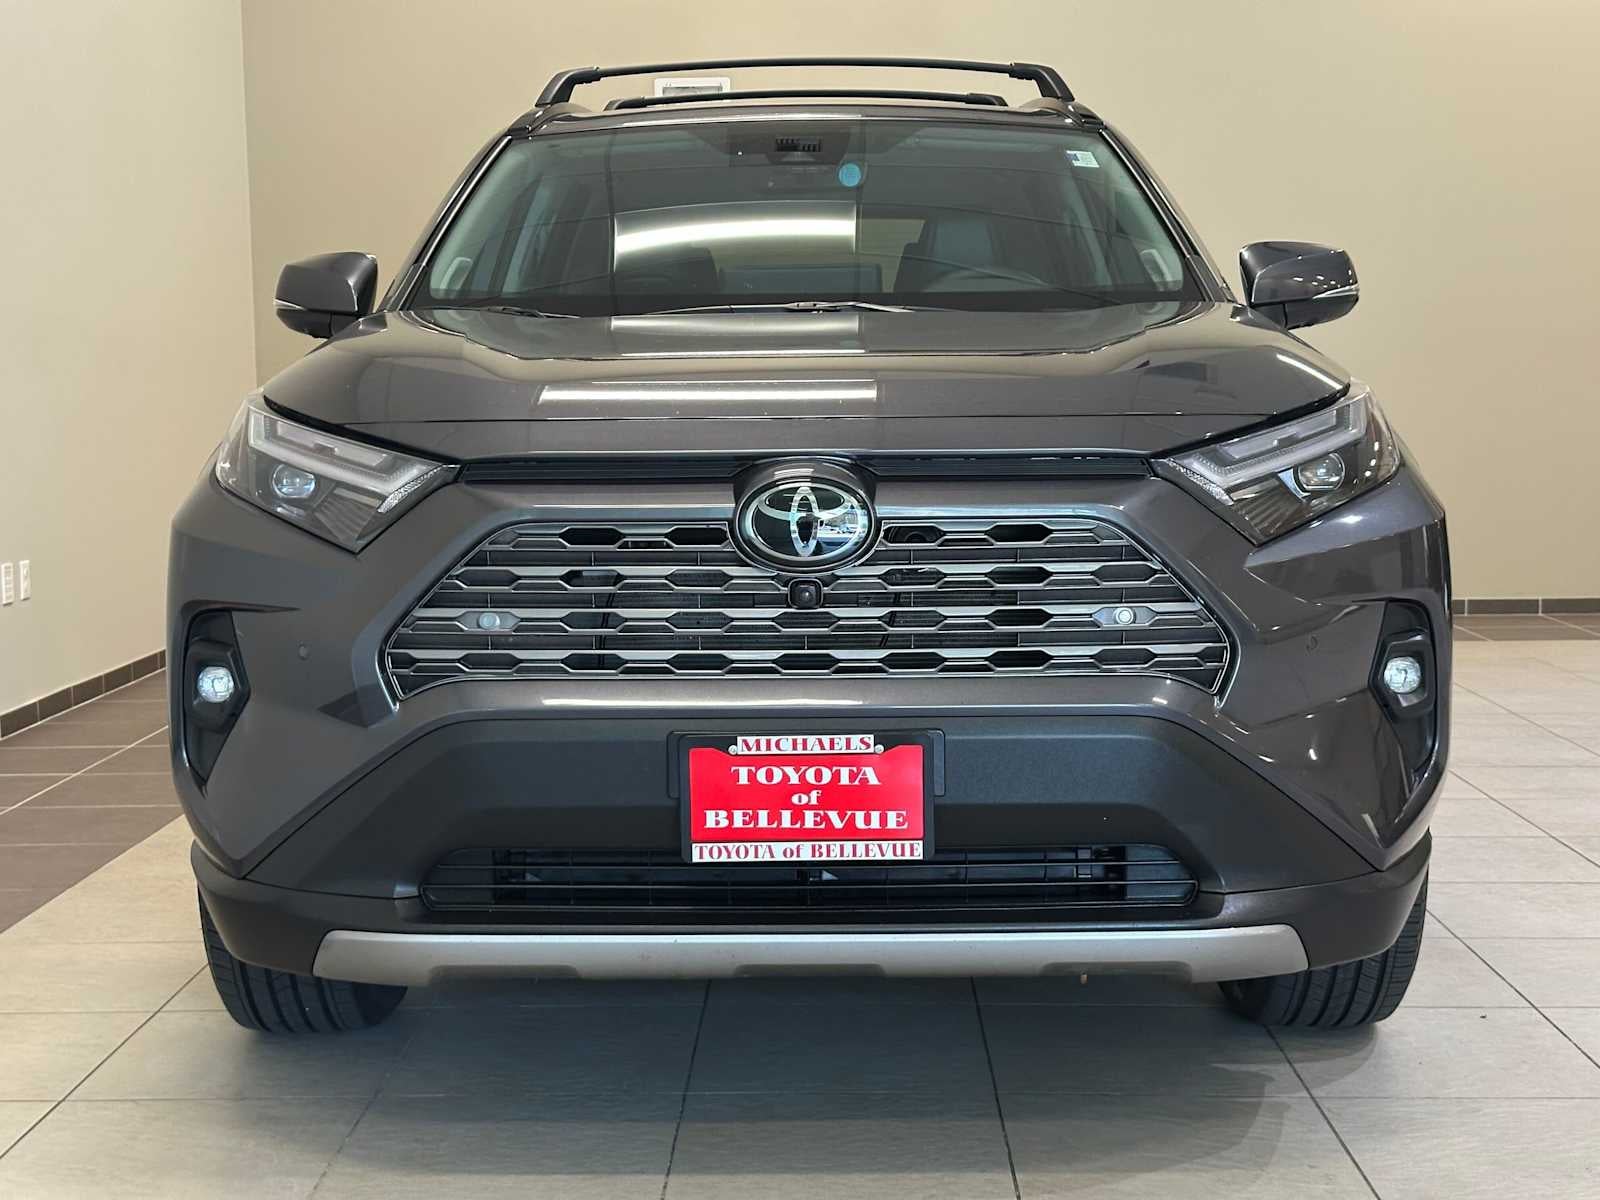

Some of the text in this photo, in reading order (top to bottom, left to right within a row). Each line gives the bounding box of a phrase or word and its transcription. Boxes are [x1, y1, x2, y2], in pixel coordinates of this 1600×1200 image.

[740, 737, 872, 753] MICHAELS
[731, 766, 881, 785] TOYOTA
[791, 789, 822, 805] of
[704, 810, 908, 829] BELLEVUE
[694, 842, 921, 860] TOYOTA of BELLEVUE
